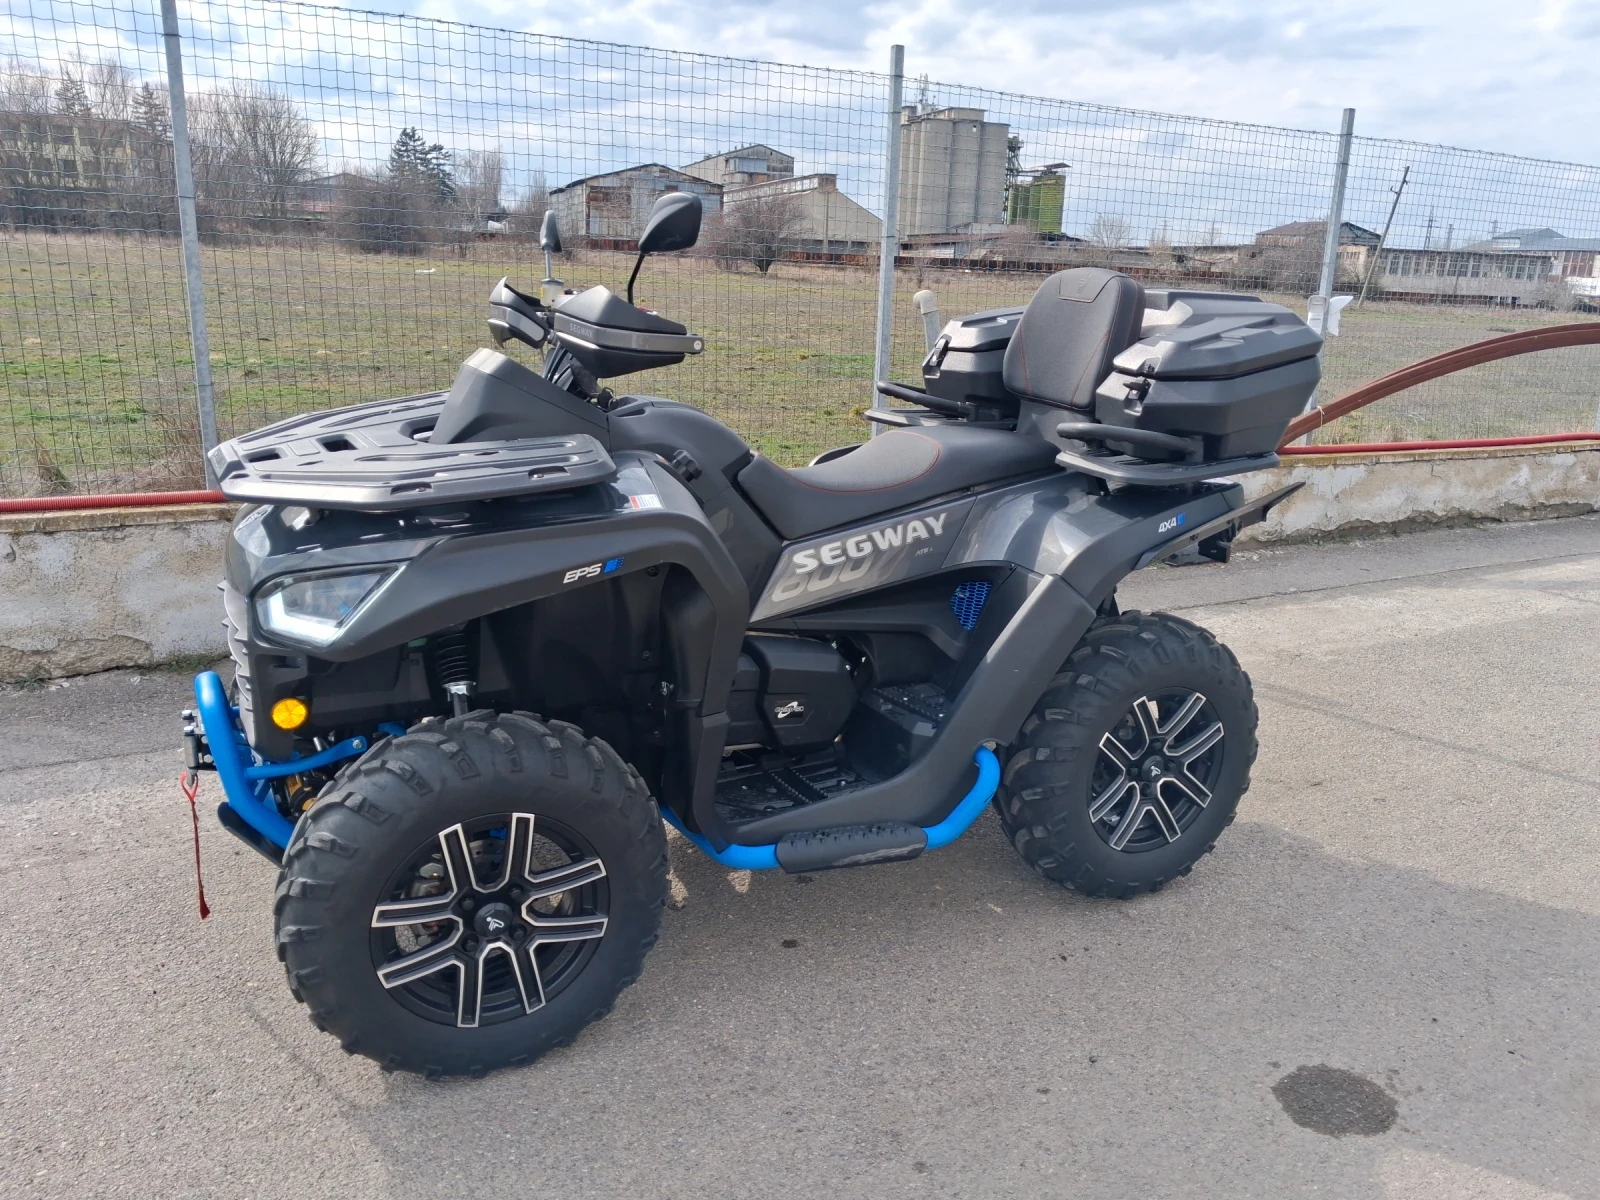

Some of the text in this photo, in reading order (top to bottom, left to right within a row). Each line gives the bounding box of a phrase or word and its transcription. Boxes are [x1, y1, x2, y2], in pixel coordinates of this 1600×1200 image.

[569, 323, 593, 338] SEGWAY
[1158, 516, 1177, 533] 4X4
[792, 512, 947, 574] SEGWAY
[563, 562, 602, 584] EPS
[771, 553, 873, 603] 600
